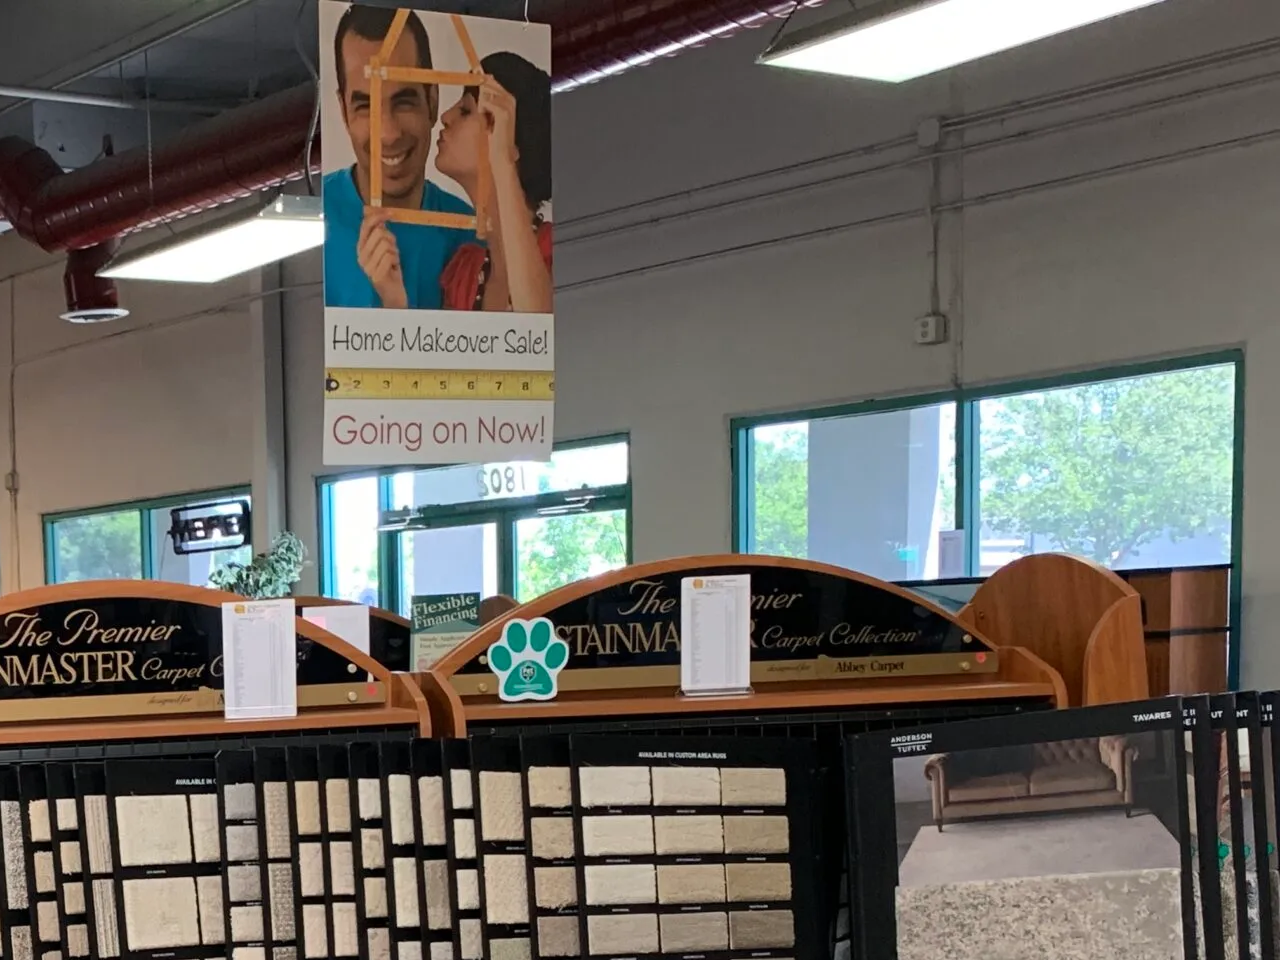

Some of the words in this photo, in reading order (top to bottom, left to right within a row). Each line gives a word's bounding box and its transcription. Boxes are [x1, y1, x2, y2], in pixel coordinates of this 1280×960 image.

[332, 325, 395, 352] Home
[401, 326, 499, 354] Makeover
[504, 329, 548, 355] Sale!
[382, 380, 391, 390] 3
[411, 381, 419, 390] 4
[440, 381, 447, 390] 5
[467, 381, 475, 390] 6
[495, 381, 502, 391] 7
[522, 382, 529, 391] 8
[333, 415, 421, 452] Going
[433, 422, 467, 444] on
[478, 415, 545, 444] Now!
[412, 594, 476, 617] Flexible
[617, 580, 676, 616] The
[57, 608, 181, 646] Premier
[414, 606, 478, 630] Financing
[761, 625, 823, 653] Carpet
[829, 622, 917, 645] Collection
[141, 657, 206, 685] Carpet
[834, 661, 865, 674] Abbey
[870, 660, 905, 674] Carpet
[1133, 711, 1172, 722] TAVARES
[890, 732, 932, 743] ANDERSON
[897, 744, 927, 753] TUFTEX
[638, 751, 667, 759] AVAILABLE
[175, 778, 205, 786] AVAILABLE
